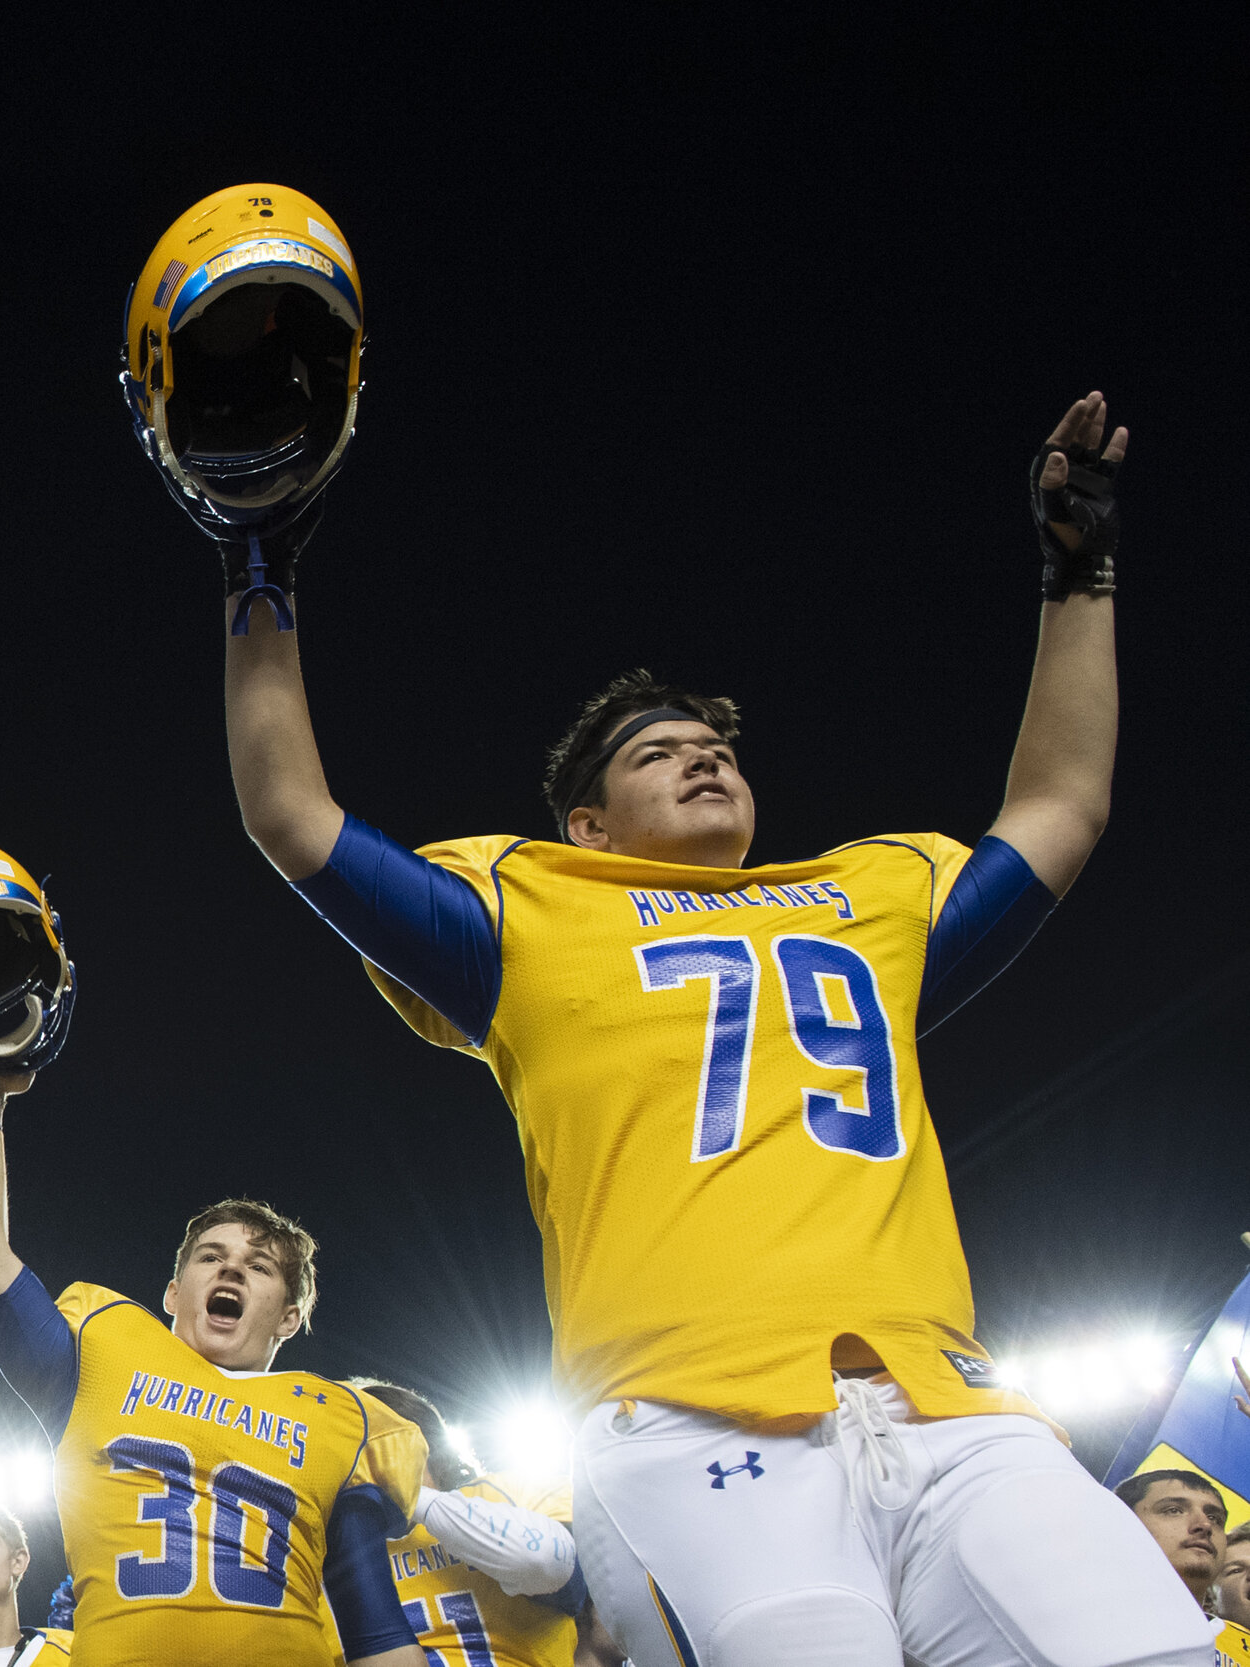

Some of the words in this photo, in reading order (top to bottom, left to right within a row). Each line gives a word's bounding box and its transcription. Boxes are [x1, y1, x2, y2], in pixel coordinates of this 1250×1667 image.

[626, 881, 855, 927] HURRICANES
[631, 933, 907, 1163] 79
[120, 1371, 308, 1470] HURRICANES
[104, 1433, 299, 1609] 30
